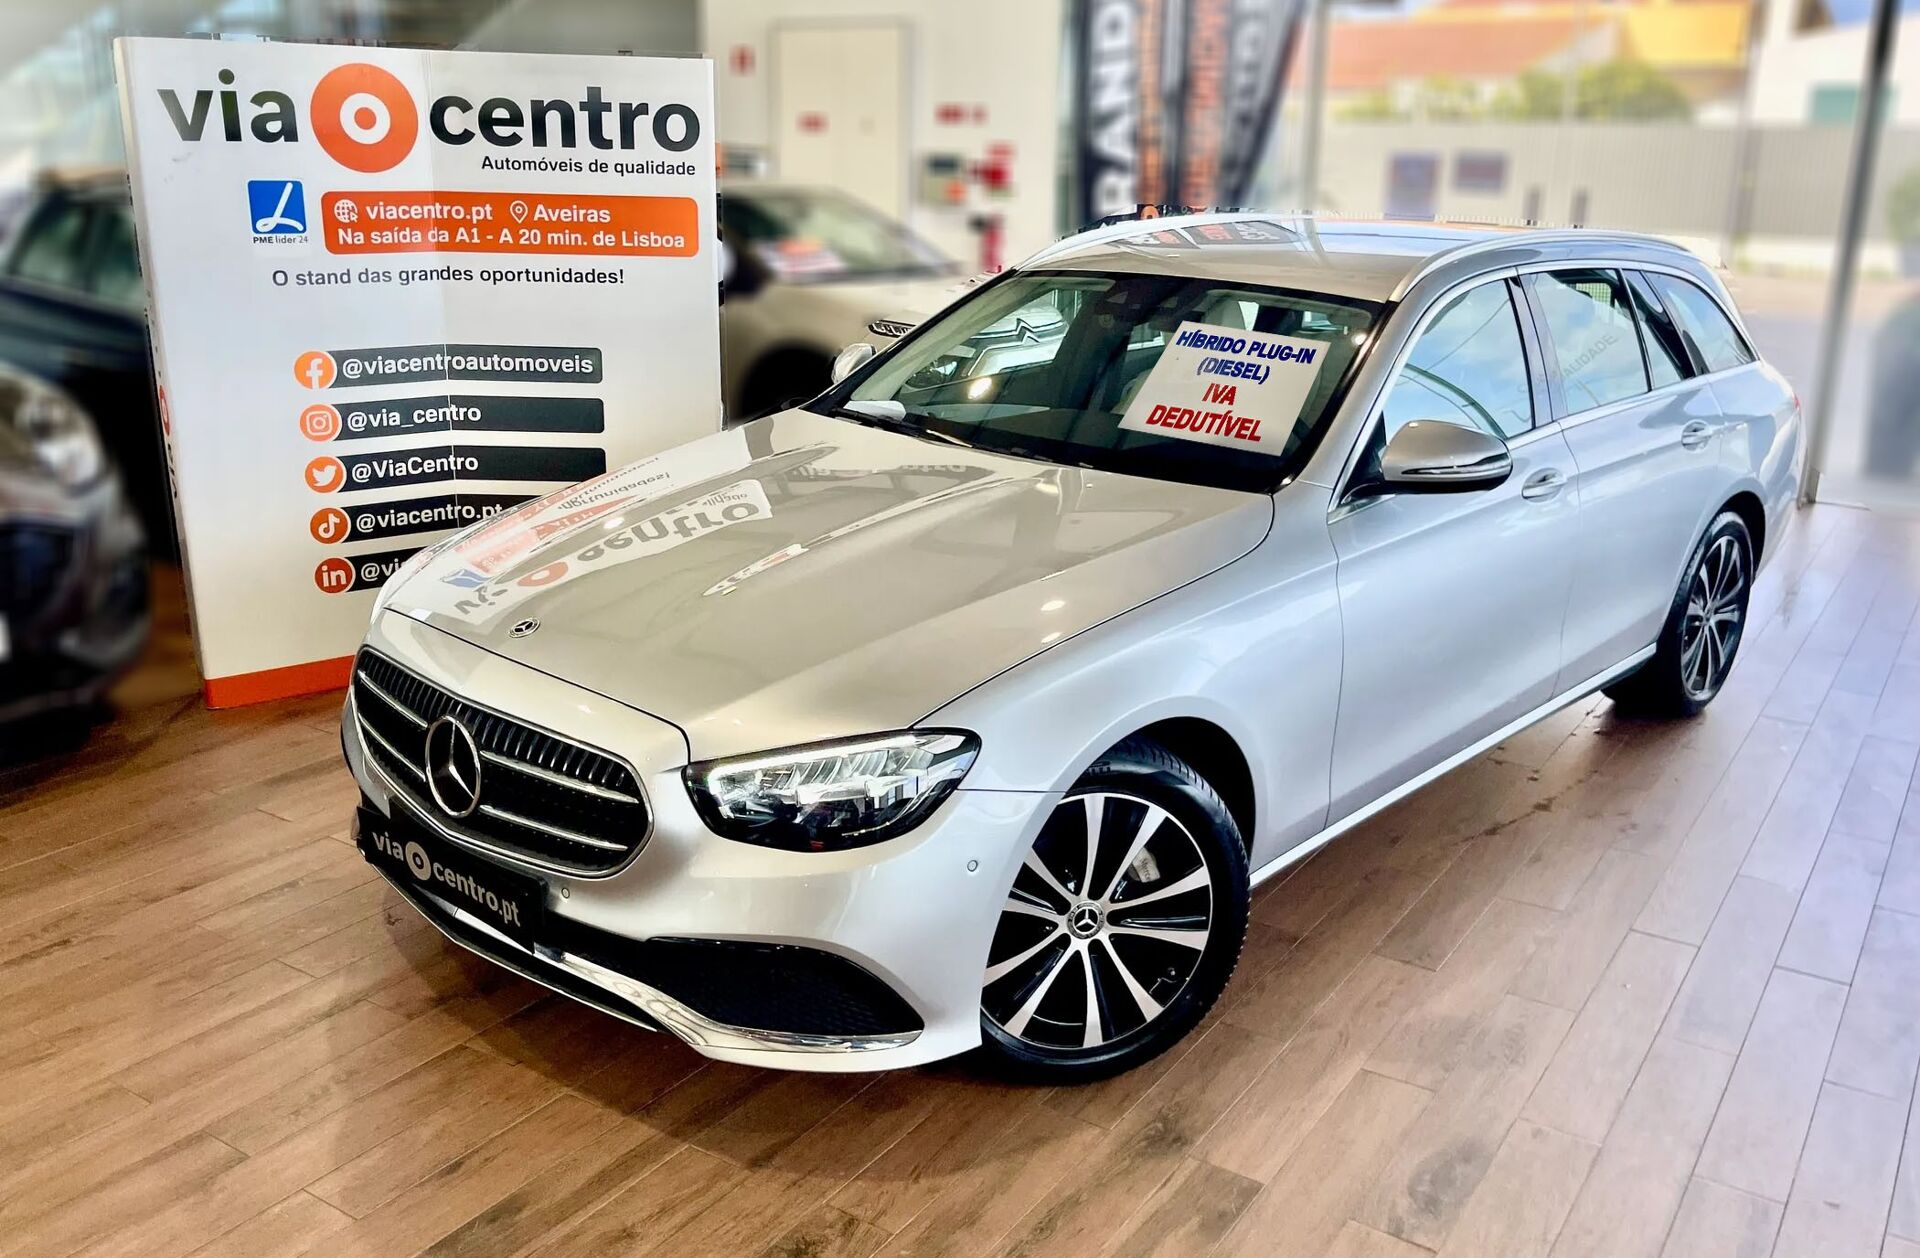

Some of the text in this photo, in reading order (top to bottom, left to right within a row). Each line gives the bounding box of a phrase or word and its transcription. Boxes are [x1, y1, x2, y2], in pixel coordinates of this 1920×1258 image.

[156, 68, 700, 152] via centro
[481, 155, 696, 177] Automóveis de qualidade
[366, 202, 611, 223] viacentro.pt Aveiras
[253, 236, 274, 244] PME
[338, 228, 365, 244] Na
[371, 226, 420, 243] saída
[428, 227, 449, 242] da
[455, 227, 480, 243] A1
[499, 228, 513, 244] A
[519, 229, 541, 245] 20
[547, 230, 587, 246] min.
[593, 231, 616, 247] de
[622, 232, 685, 248] Lisboa
[272, 266, 625, 286] O stand das grandes oportunidades!
[1176, 329, 1316, 364] HÍBRIDO PLUG-IN
[343, 354, 594, 379] @viacentroautomoveis
[1197, 356, 1270, 384] (DIESEL)
[1202, 383, 1237, 406] IVA
[347, 404, 482, 432] @via_centro
[1146, 404, 1261, 442] DEDUTÍVEL
[352, 455, 479, 482] @ViaCentro
[356, 504, 502, 533] @viacentro.pt
[372, 832, 521, 927] via centro.pt
